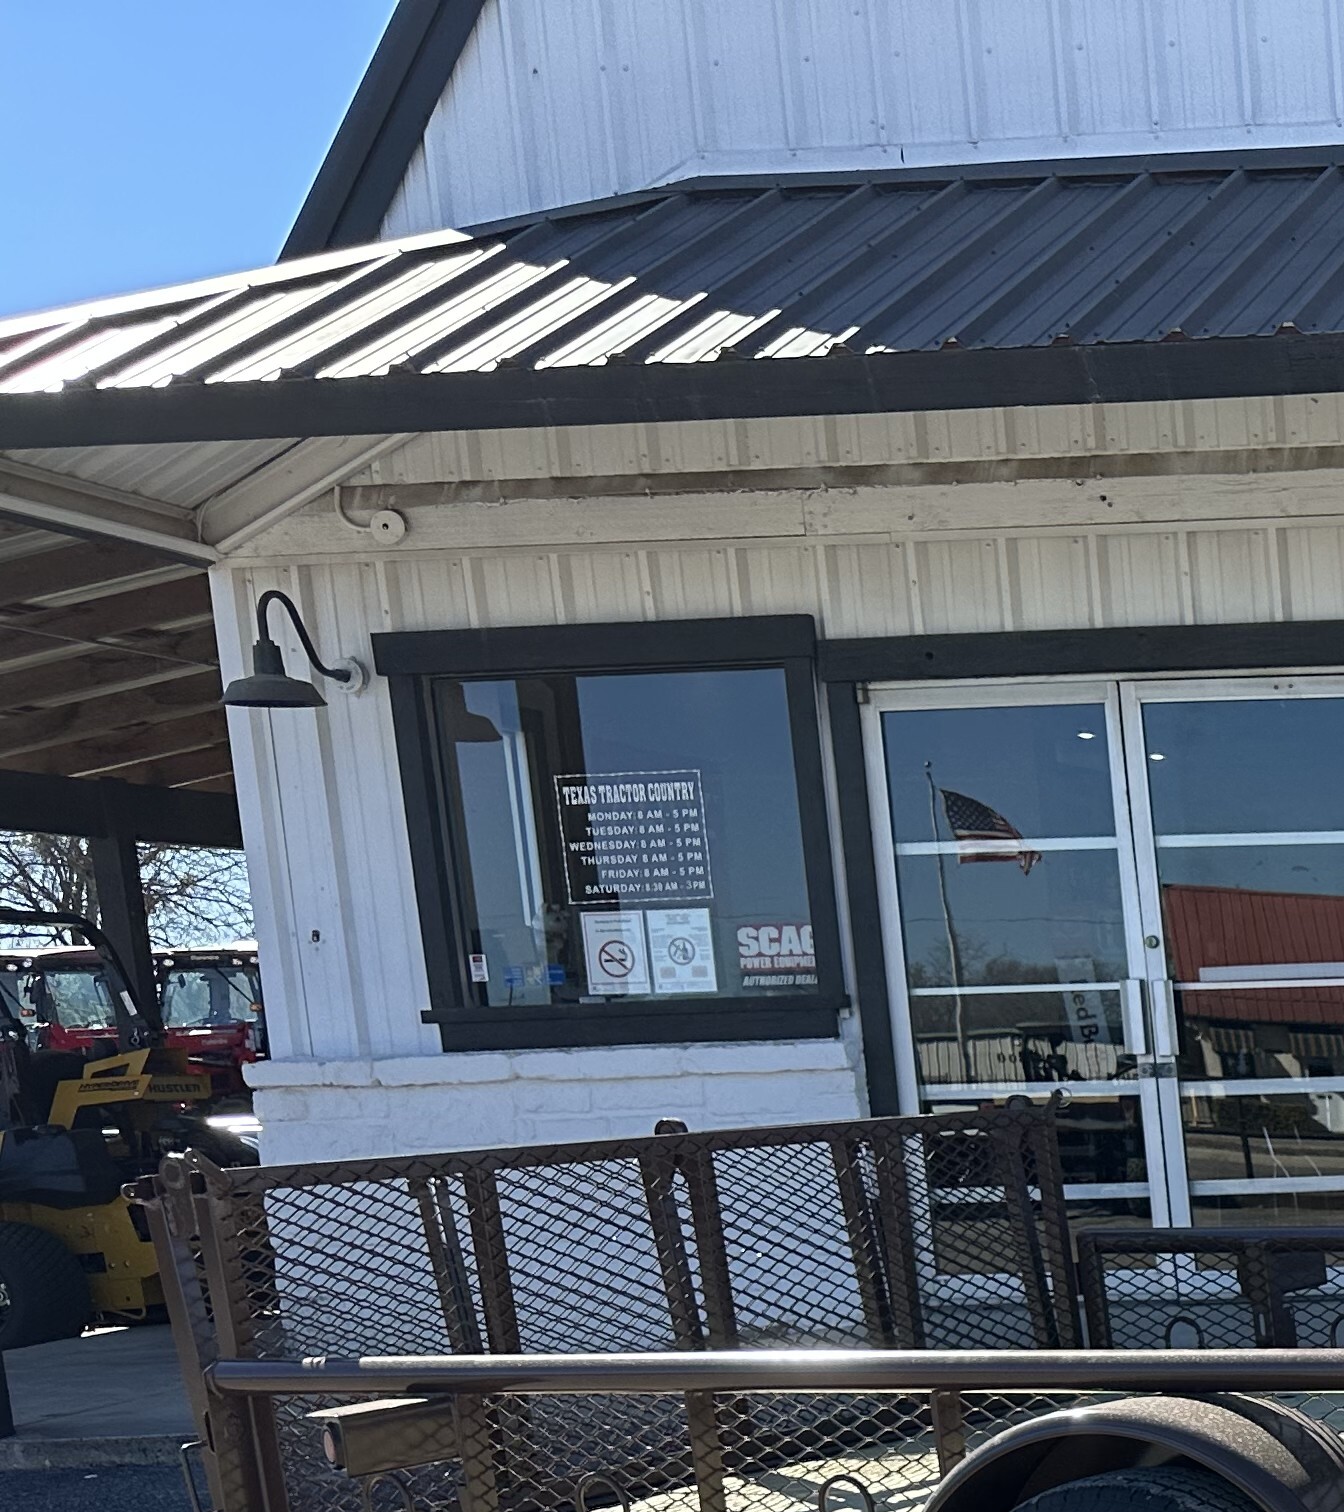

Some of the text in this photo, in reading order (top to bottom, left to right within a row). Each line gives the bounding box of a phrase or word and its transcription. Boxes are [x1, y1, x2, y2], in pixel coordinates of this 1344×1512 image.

[562, 781, 694, 805] TEXAS TRACTOR COUNTRY
[637, 810, 643, 819] 8
[647, 810, 662, 819] AM
[673, 809, 679, 818] 5
[682, 808, 698, 817] PM
[639, 825, 645, 834] 8
[648, 824, 664, 833] AM
[674, 823, 680, 833] 5
[683, 823, 699, 832] PM
[641, 839, 647, 848] 8
[650, 839, 665, 848] AM
[676, 838, 682, 847] 5
[685, 837, 701, 846] PM
[642, 854, 648, 863] 8
[651, 853, 667, 862] AM
[678, 852, 684, 861] 5
[687, 852, 702, 861] PM
[644, 868, 650, 877] 8
[653, 867, 669, 877] AM
[680, 867, 685, 876] 5
[688, 866, 704, 875] PM
[665, 882, 678, 891] AM
[686, 880, 692, 889] 3
[693, 880, 706, 890] PM
[740, 957, 772, 969] POWER
[743, 975, 794, 987] AUTHORIZED
[148, 1083, 200, 1093] HUSTLER
